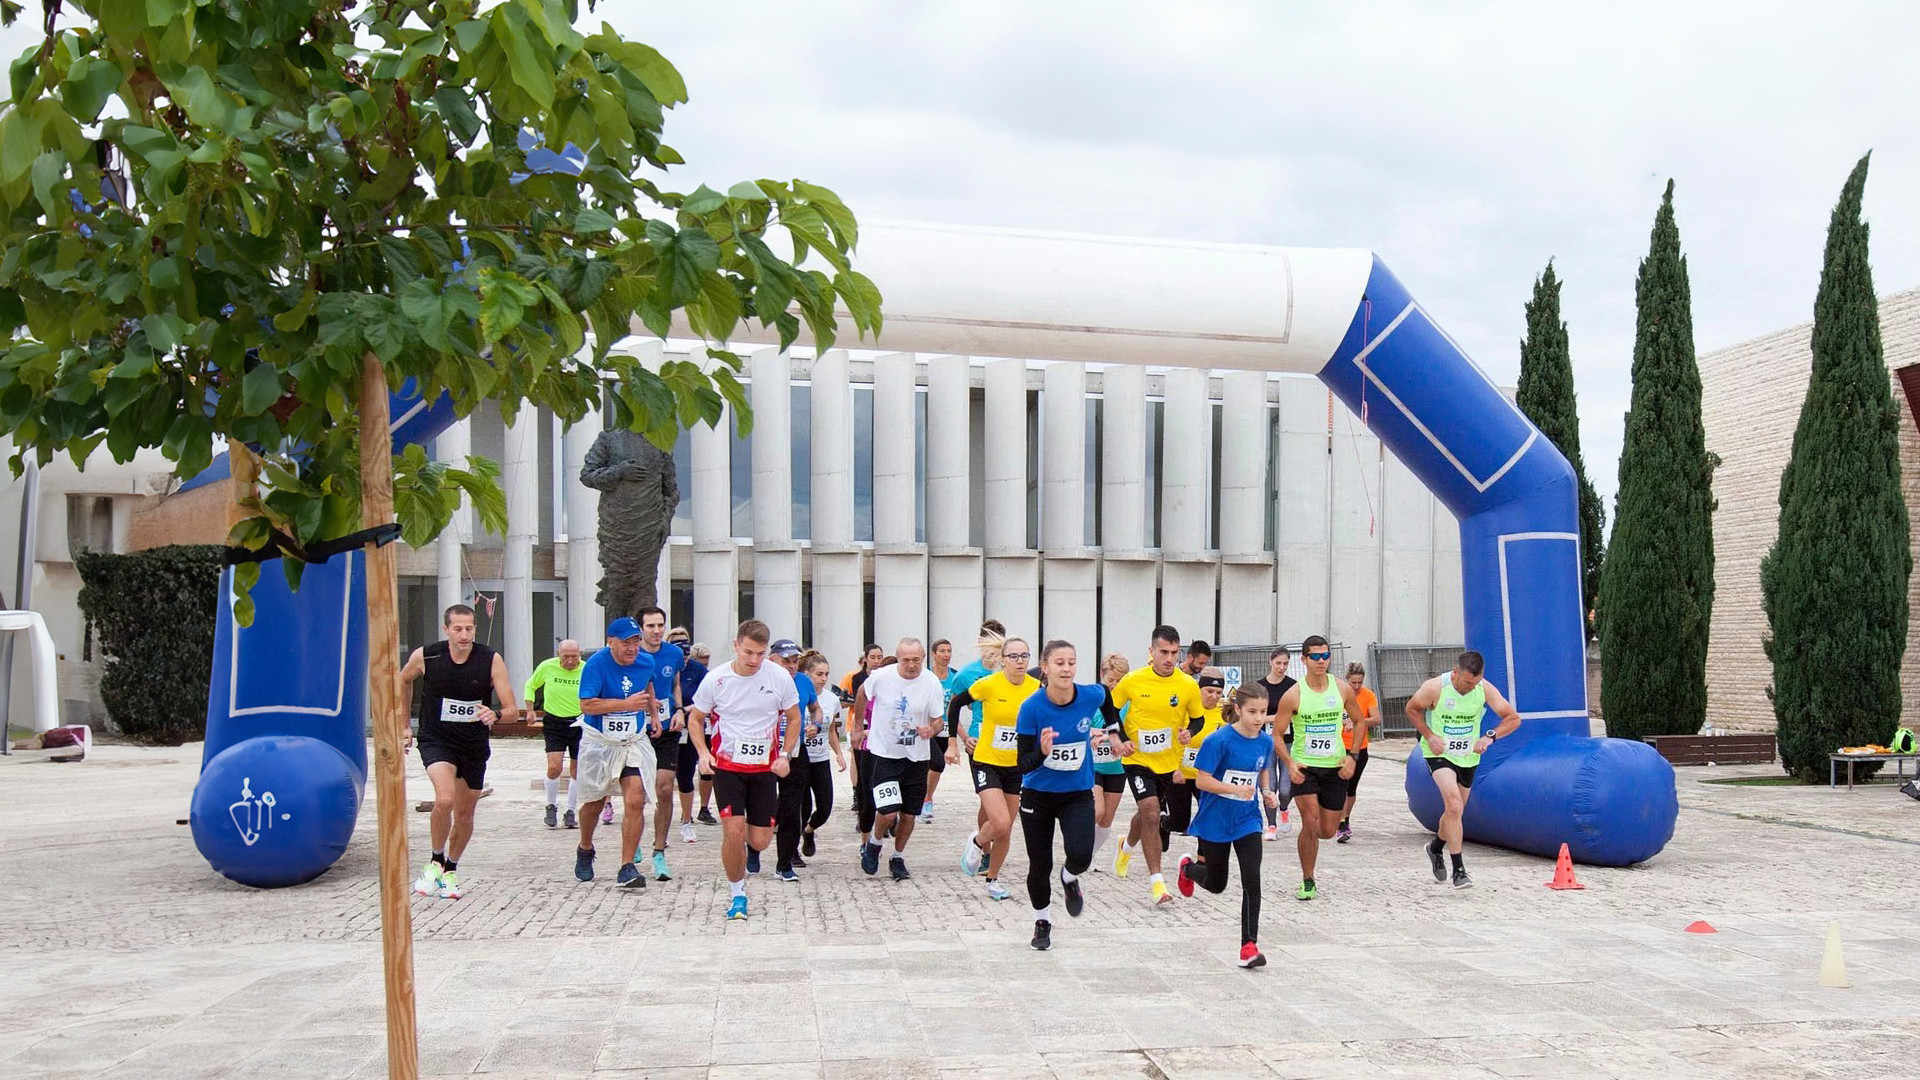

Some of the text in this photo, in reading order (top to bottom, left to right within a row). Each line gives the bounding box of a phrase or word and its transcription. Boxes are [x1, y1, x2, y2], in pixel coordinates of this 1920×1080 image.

[449, 704, 474, 716] 586
[608, 721, 631, 733] 587
[805, 738, 823, 748] 594
[1144, 733, 1165, 745] 503
[1310, 739, 1331, 749] 576
[1448, 740, 1468, 750] 585
[741, 744, 765, 756] 535
[1051, 748, 1078, 761] 561
[1097, 746, 1114, 757] 59
[879, 786, 898, 799] 590
